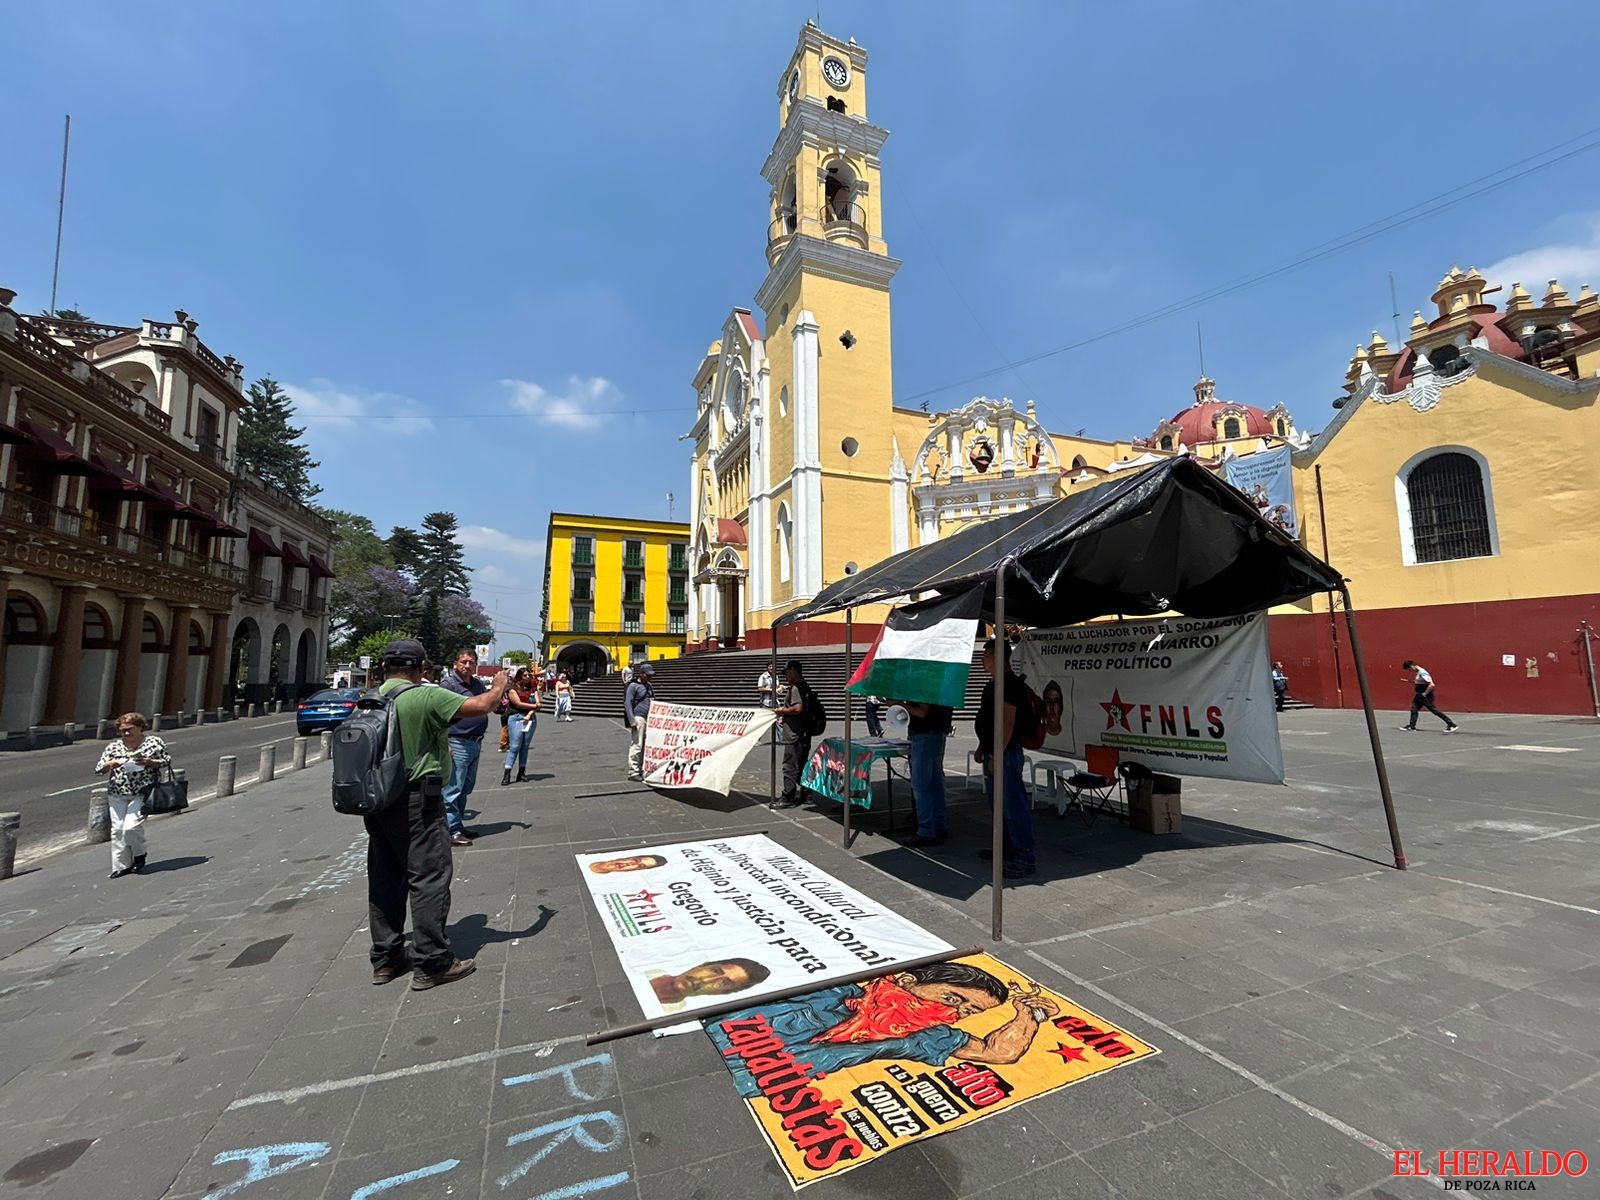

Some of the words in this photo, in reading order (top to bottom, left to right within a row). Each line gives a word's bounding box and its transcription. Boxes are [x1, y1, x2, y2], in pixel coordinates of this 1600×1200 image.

[1079, 627, 1130, 639] LUCHADOR
[1132, 625, 1156, 636] POR
[1159, 624, 1173, 634] EL
[1175, 614, 1257, 633] SOCIALISMO
[1041, 644, 1081, 656] HIGINIO
[1085, 641, 1136, 654] BUSTOS
[1064, 659, 1102, 670] PRESO
[1105, 655, 1172, 670] POLÍTICO
[714, 710, 755, 723] NAVARRO
[1140, 704, 1225, 739] FNLS
[667, 881, 718, 926] Gregorio
[765, 855, 810, 881] Misión
[800, 880, 879, 921] Cultural
[767, 937, 827, 974] para
[721, 1013, 864, 1170] zapatistas
[908, 1080, 960, 1122] guerra
[942, 1062, 1006, 1108] alto
[846, 1110, 859, 1122] los
[853, 1121, 883, 1150] pueblos
[860, 1084, 922, 1136] contra
